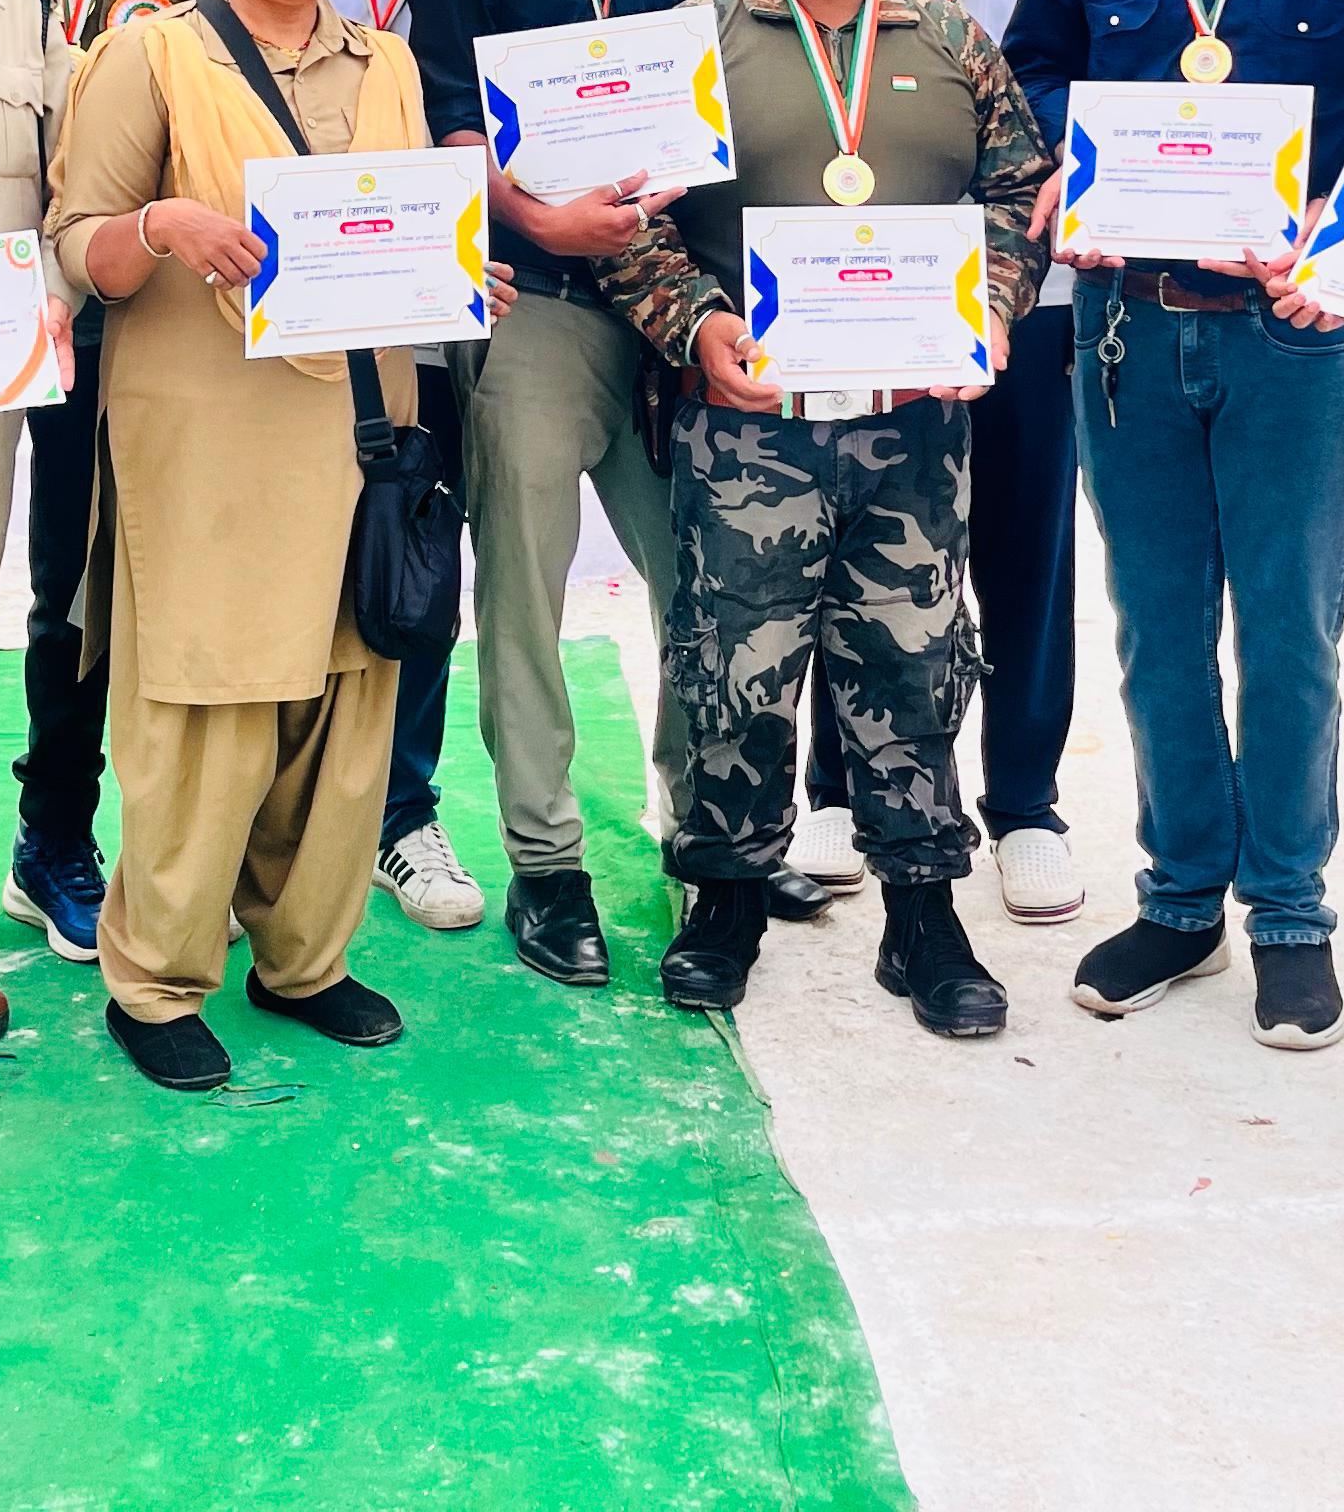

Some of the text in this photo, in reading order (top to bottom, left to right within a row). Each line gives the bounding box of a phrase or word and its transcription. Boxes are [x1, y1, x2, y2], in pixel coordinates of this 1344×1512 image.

[634, 60, 675, 74] जबलपुर
[293, 210, 309, 220] वन
[400, 201, 441, 215] जबलपुर
